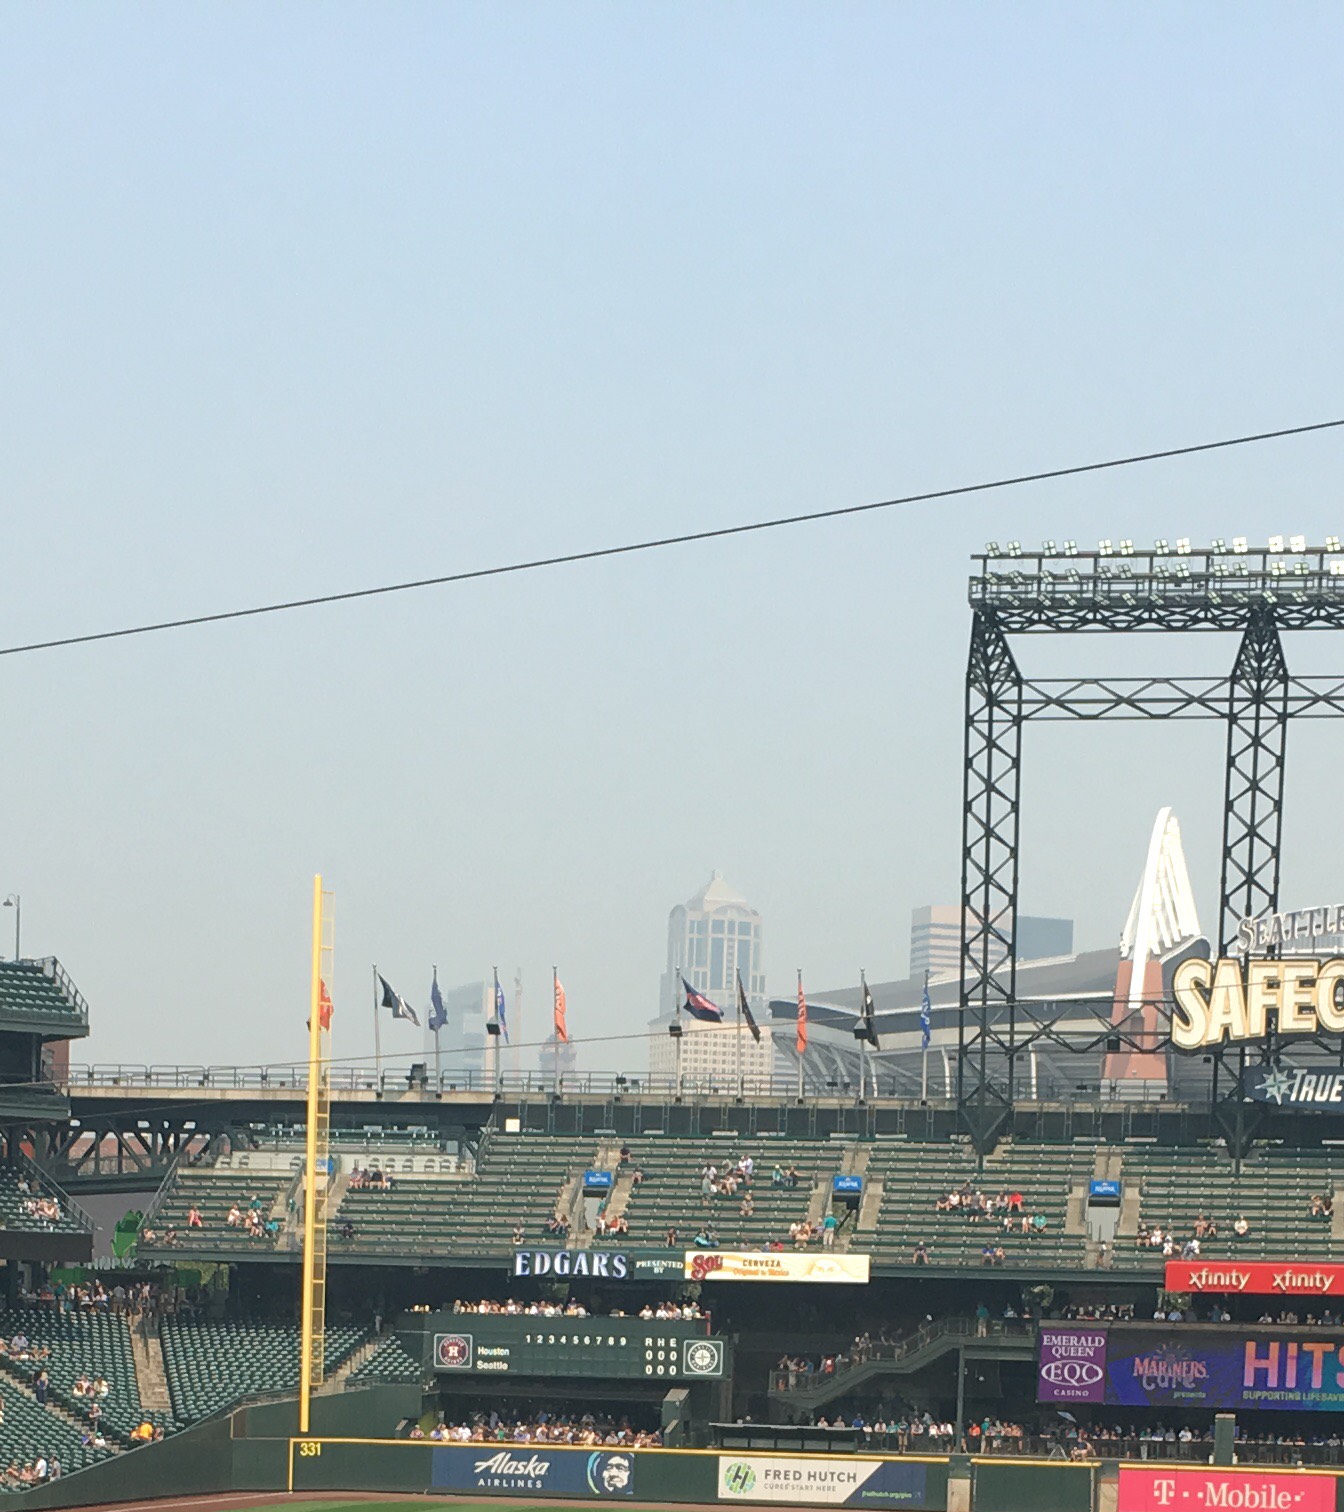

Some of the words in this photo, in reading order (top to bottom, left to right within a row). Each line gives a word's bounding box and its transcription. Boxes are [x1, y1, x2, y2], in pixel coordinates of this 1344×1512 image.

[635, 1259, 684, 1271] PRESENTED
[742, 1258, 782, 1269] CERVEZA
[1188, 1268, 1251, 1290] xfinity
[1272, 1269, 1335, 1291] xfinity
[525, 1335, 532, 1344] 1
[536, 1335, 544, 1345] 2
[548, 1335, 555, 1345] 3
[559, 1335, 567, 1345] 4
[572, 1336, 580, 1345] 5
[583, 1336, 591, 1345] 6
[595, 1336, 603, 1346] 7
[607, 1336, 615, 1346] 8
[619, 1336, 627, 1346] 9
[644, 1337, 653, 1347] R
[657, 1338, 665, 1347] H
[669, 1338, 677, 1348] E
[1043, 1335, 1105, 1347] EMERALD
[477, 1346, 510, 1356] Houston
[645, 1350, 653, 1361] 0
[657, 1350, 665, 1361] 0
[669, 1350, 677, 1361] 0
[1051, 1347, 1095, 1358] QUEEN
[476, 1360, 509, 1371] Seattle
[645, 1364, 653, 1375] 0
[656, 1364, 665, 1375] 0
[668, 1365, 677, 1375] 0
[1050, 1362, 1096, 1387] EQC
[1053, 1389, 1090, 1397] CASINO
[1242, 1390, 1302, 1401] SUPPORTING
[300, 1442, 322, 1457] 331
[474, 1452, 550, 1476] Alaska
[764, 1469, 803, 1482] FRED
[807, 1470, 857, 1483] HUTCH
[478, 1478, 543, 1489] AIRLINES
[790, 1484, 815, 1492] START
